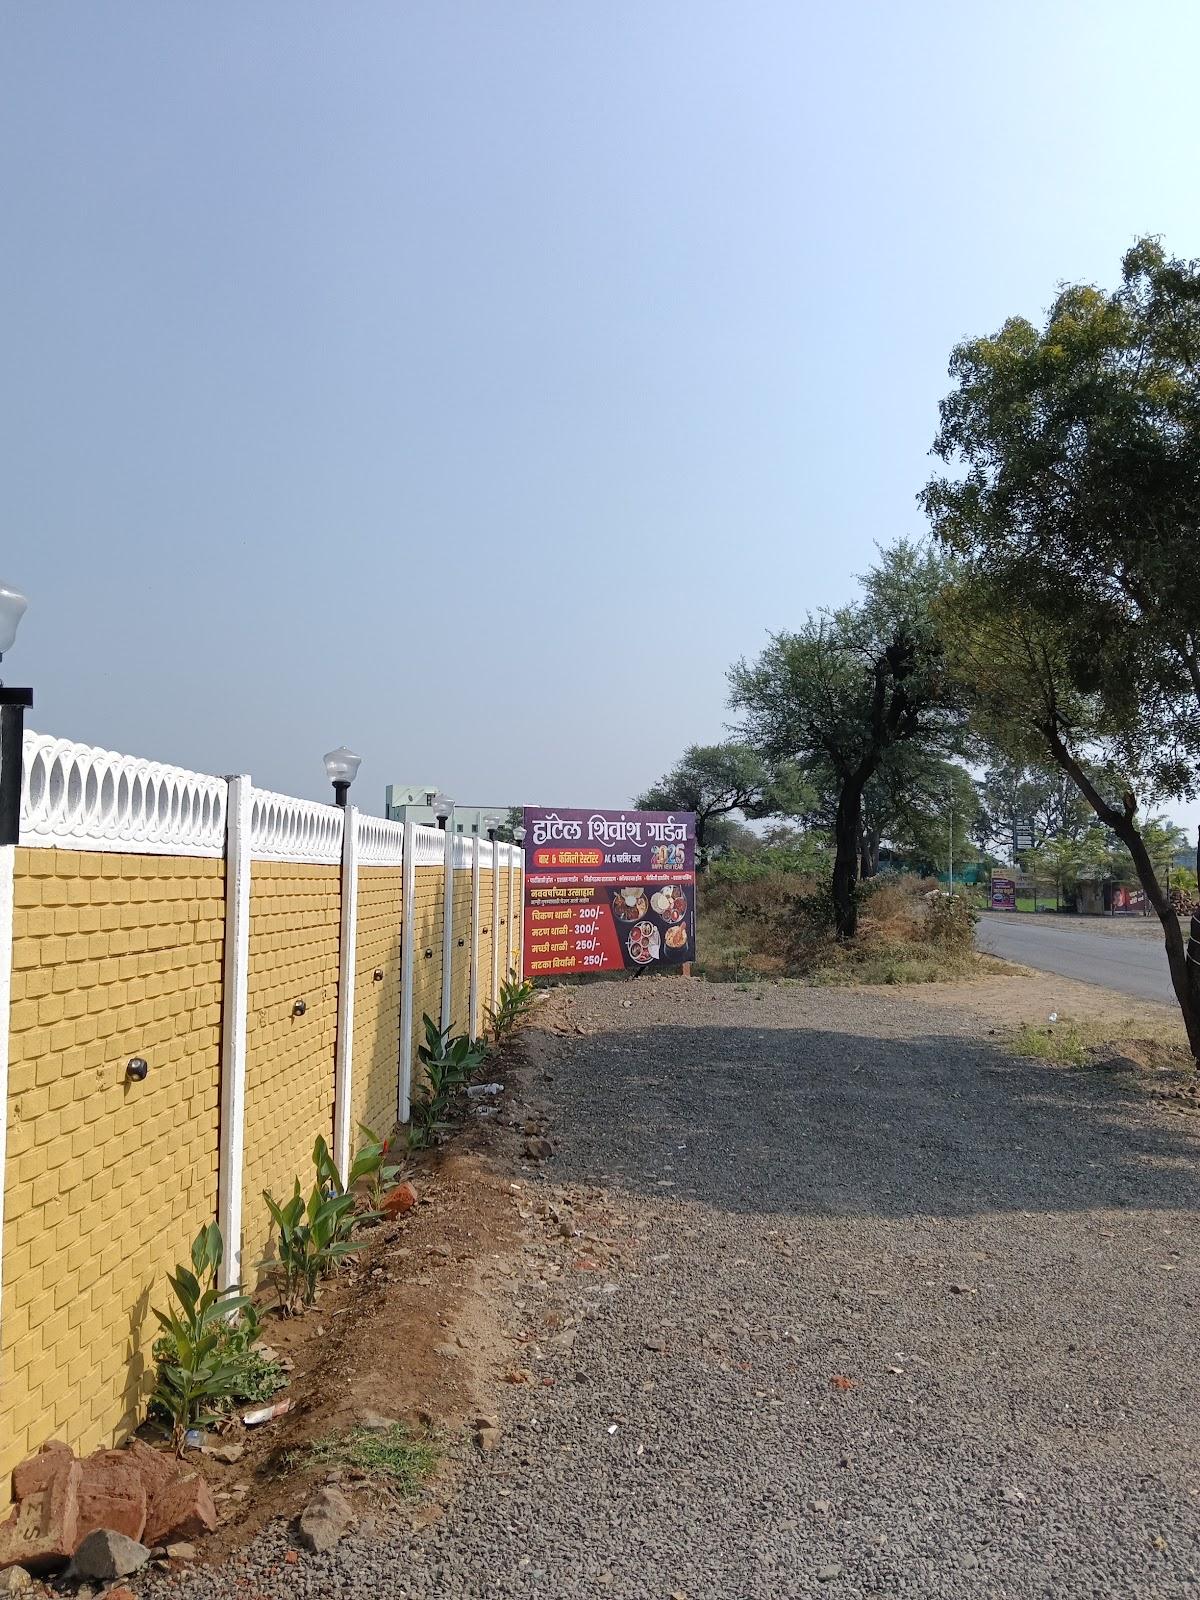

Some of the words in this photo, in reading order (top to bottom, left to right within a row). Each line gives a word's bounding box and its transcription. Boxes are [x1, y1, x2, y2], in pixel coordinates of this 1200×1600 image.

[532, 813, 583, 845] हॉटेल
[587, 814, 647, 847] शिवांश
[646, 815, 688, 841] गार्डन
[579, 906, 604, 919] 200/-
[574, 921, 599, 935] 300/-
[575, 937, 601, 951] 250/-
[583, 952, 608, 966] 250/-
